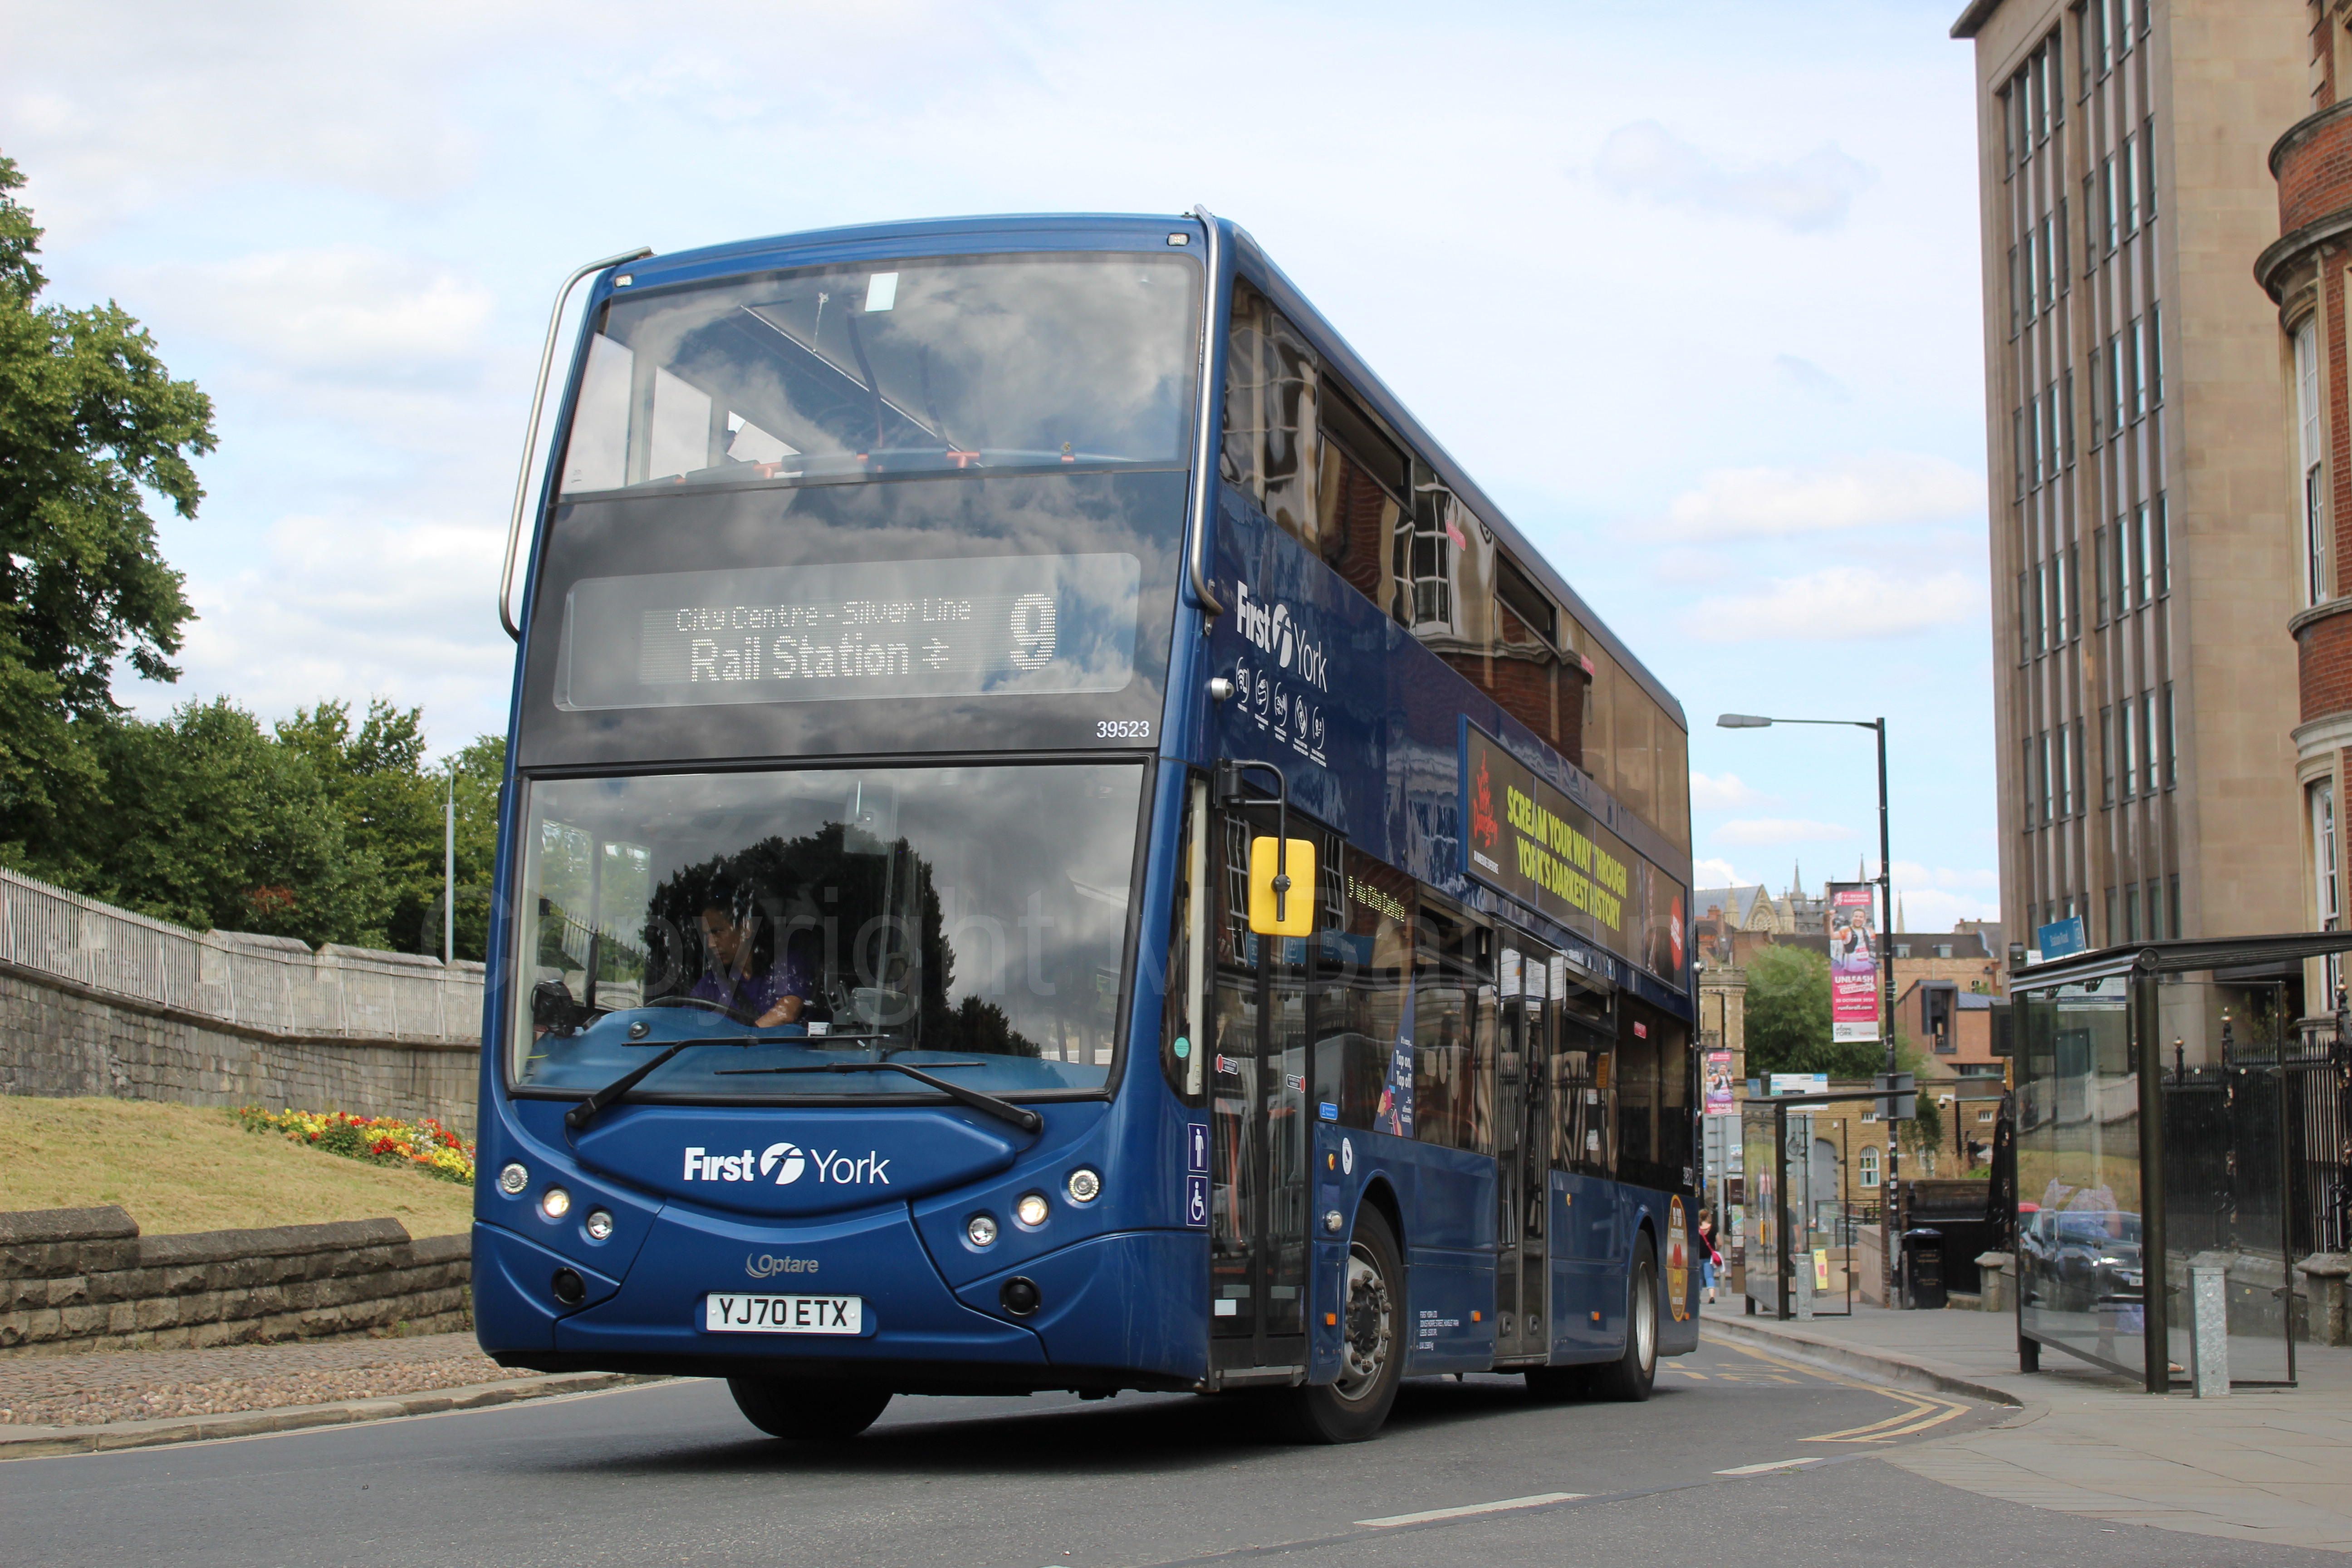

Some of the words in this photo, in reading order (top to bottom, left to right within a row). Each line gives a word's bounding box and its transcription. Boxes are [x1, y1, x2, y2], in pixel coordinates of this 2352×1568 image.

[676, 608, 725, 632] City
[732, 604, 818, 629] Centre
[842, 601, 915, 625] Silver
[923, 597, 971, 621] Line
[1009, 593, 1056, 670] 9
[1237, 580, 1270, 653] First
[1294, 622, 1327, 693] York
[691, 636, 760, 681] Rail
[772, 632, 908, 679] Station
[1096, 720, 1150, 738] 39523
[1507, 785, 1547, 845] SCREAM
[1548, 812, 1572, 862] YOUR
[1573, 830, 1592, 873] WAY
[1592, 844, 1626, 899] THROUGH
[1348, 876, 1354, 898] 9
[1357, 881, 1366, 904] via
[1367, 885, 1382, 911] City
[1383, 892, 1405, 922] Centre
[1517, 836, 1551, 890] YORK'S
[1552, 858, 1588, 912] DARKEST
[1590, 882, 1621, 932] HISTORY
[1834, 975, 1874, 984] UNLEASH
[1396, 1049, 1404, 1070] Tap
[1396, 1070, 1405, 1090] Tap
[683, 1147, 755, 1181] First
[810, 1149, 891, 1184] York
[758, 1254, 819, 1276] Optare
[720, 1298, 786, 1325] YJ70
[796, 1299, 848, 1326] ETX
